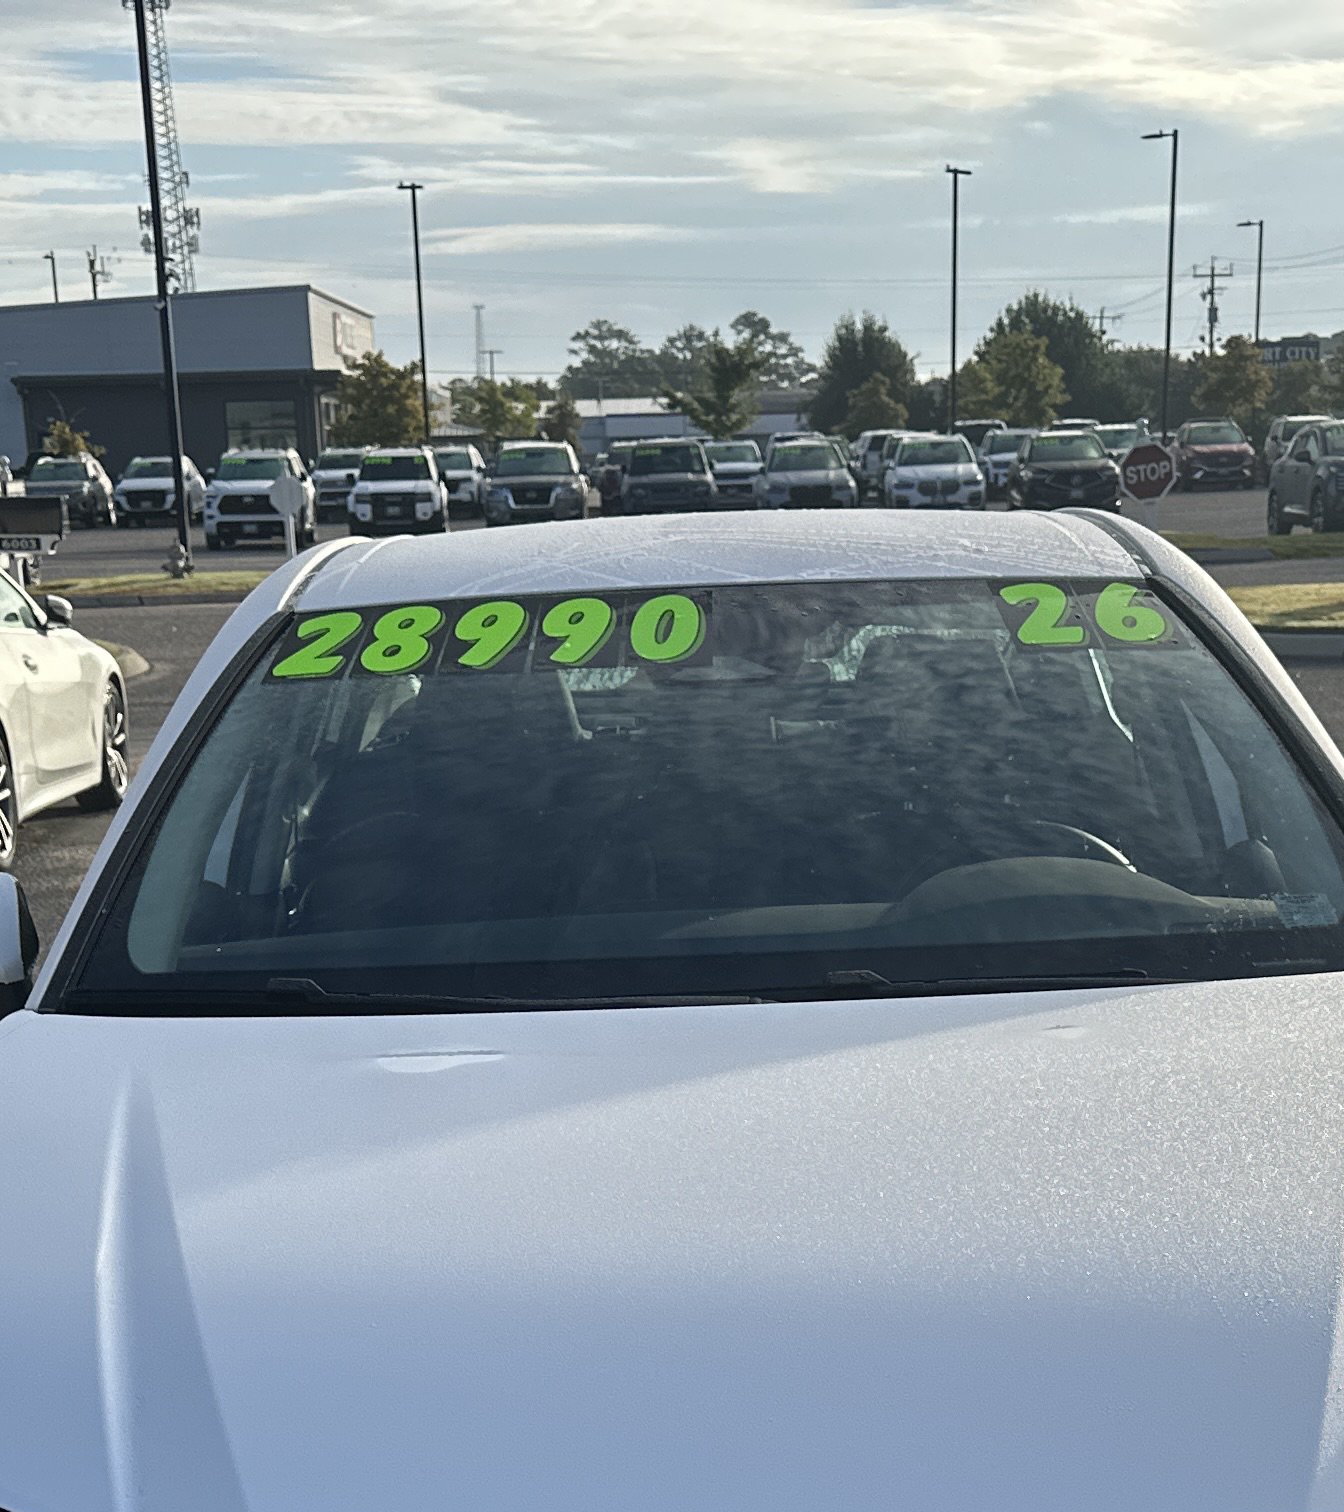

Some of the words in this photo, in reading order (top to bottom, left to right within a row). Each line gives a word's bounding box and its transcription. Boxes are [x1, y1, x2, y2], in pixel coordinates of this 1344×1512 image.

[1286, 346, 1316, 360] CITY
[1125, 460, 1171, 485] STOP
[272, 595, 706, 678] 28990
[999, 581, 1173, 645] 26
